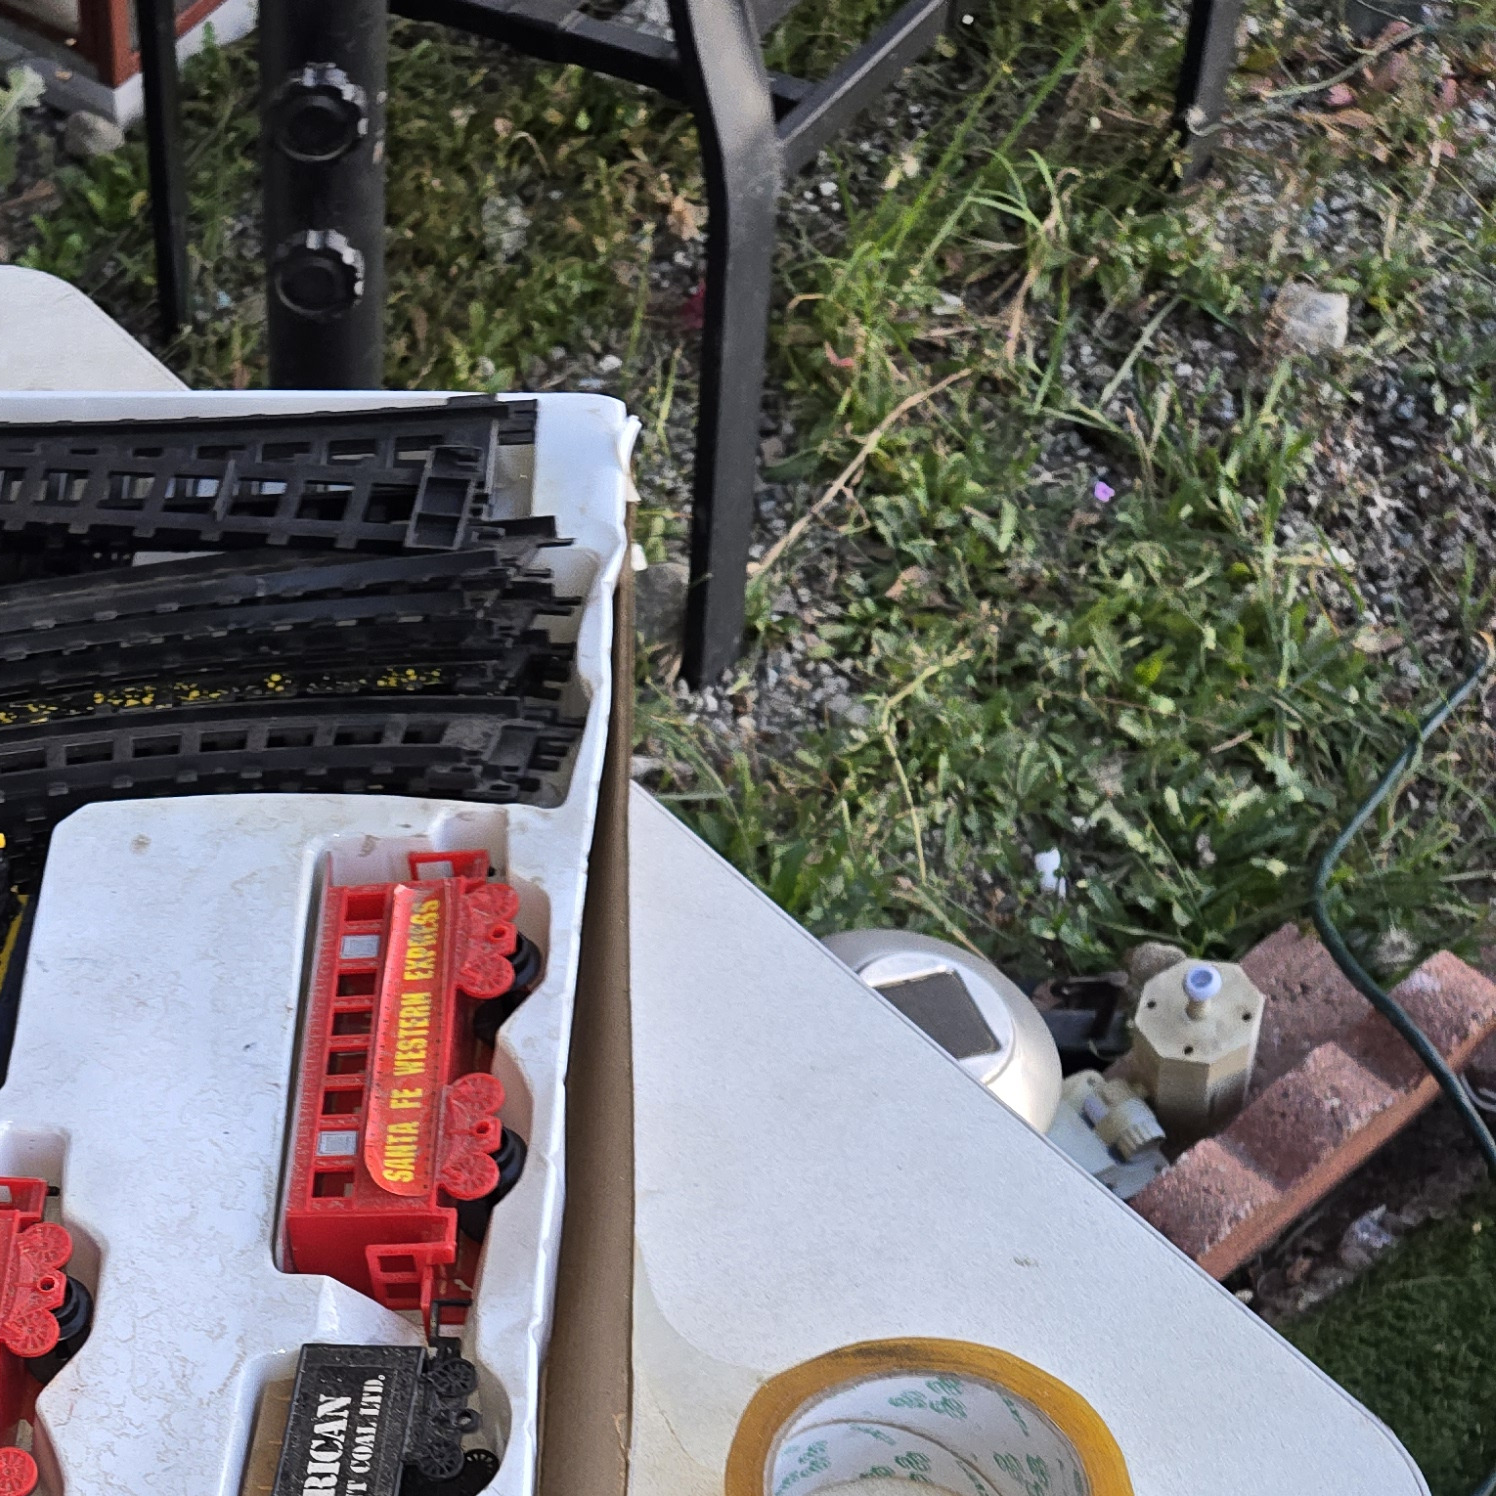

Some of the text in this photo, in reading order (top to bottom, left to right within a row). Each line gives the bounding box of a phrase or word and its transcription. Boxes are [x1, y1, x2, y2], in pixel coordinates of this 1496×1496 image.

[382, 899, 441, 1183] SANTA FE WESTERN EXPRESS
[350, 1422, 378, 1474] COAL
